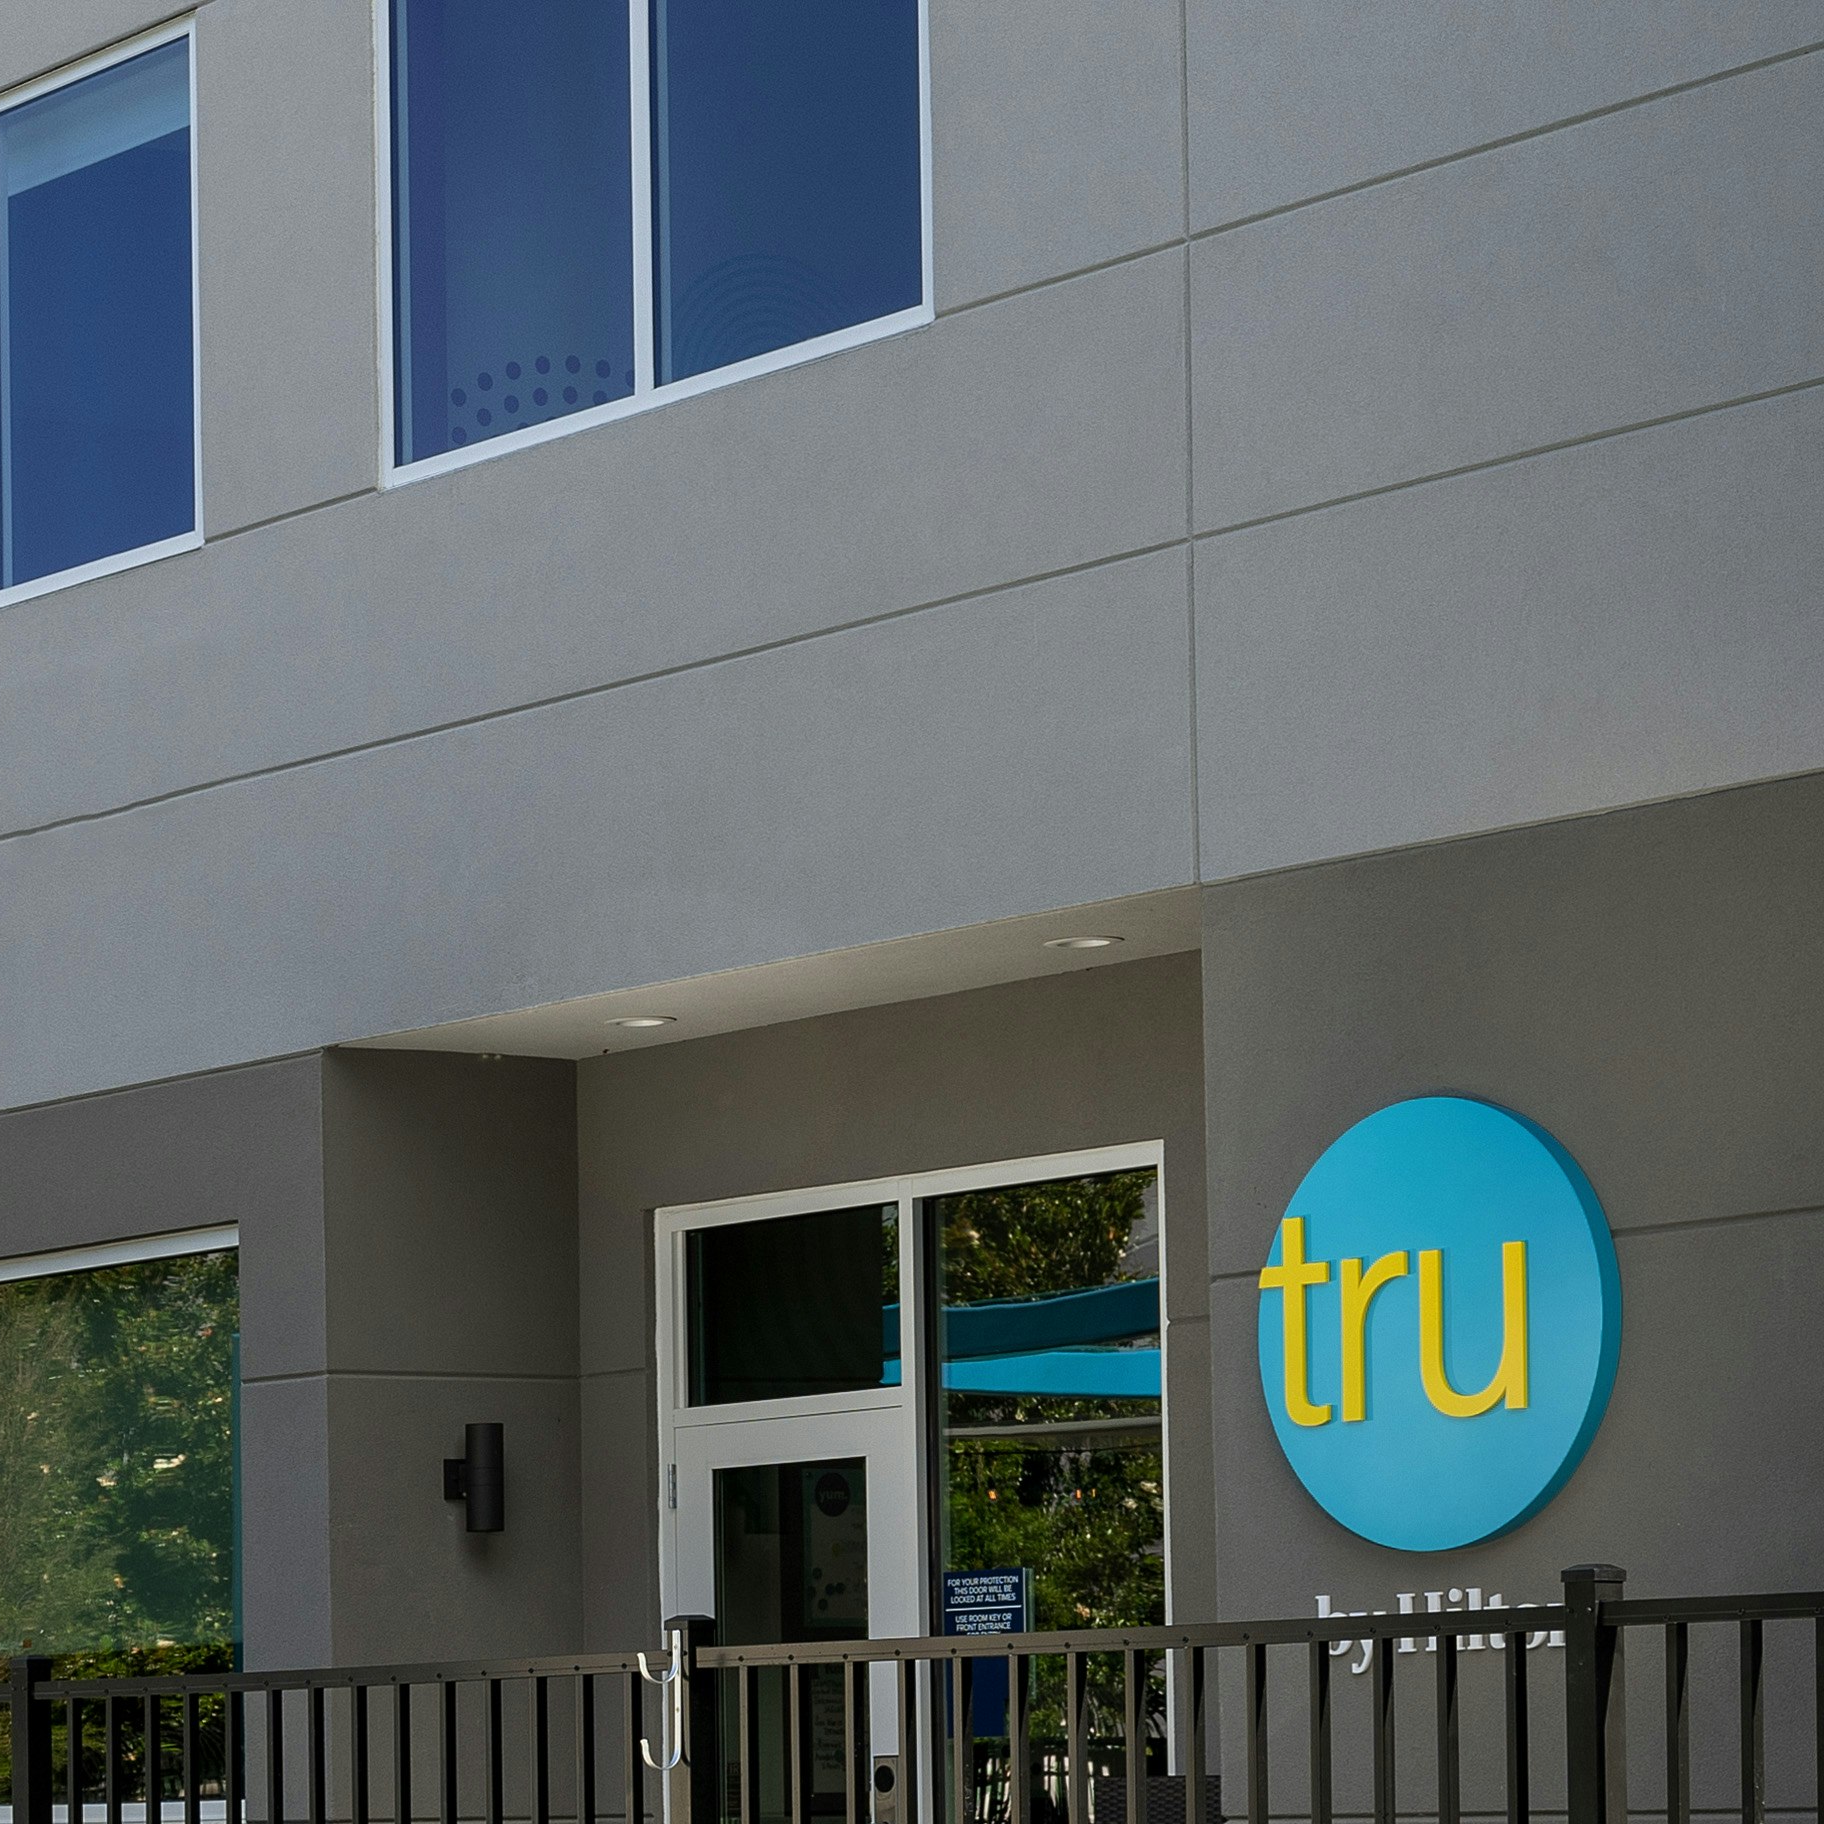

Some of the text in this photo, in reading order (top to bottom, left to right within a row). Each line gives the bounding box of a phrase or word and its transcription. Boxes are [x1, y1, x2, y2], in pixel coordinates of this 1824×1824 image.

[1258, 1216, 1529, 1427] tru
[947, 1576, 1019, 1587] FOR YOUR PROTECTION
[954, 1587, 968, 1595] THIS
[969, 1586, 988, 1594] DOOR
[988, 1585, 1002, 1593] WILL
[951, 1593, 1016, 1604] LOCKED AT ALL TIMES
[955, 1615, 968, 1623] USE
[968, 1614, 988, 1622] ROOM
[989, 1613, 1001, 1621] KEY
[956, 1622, 1011, 1632] FRONT ENTRANCE
[1314, 1587, 1566, 1674] by Hilt
